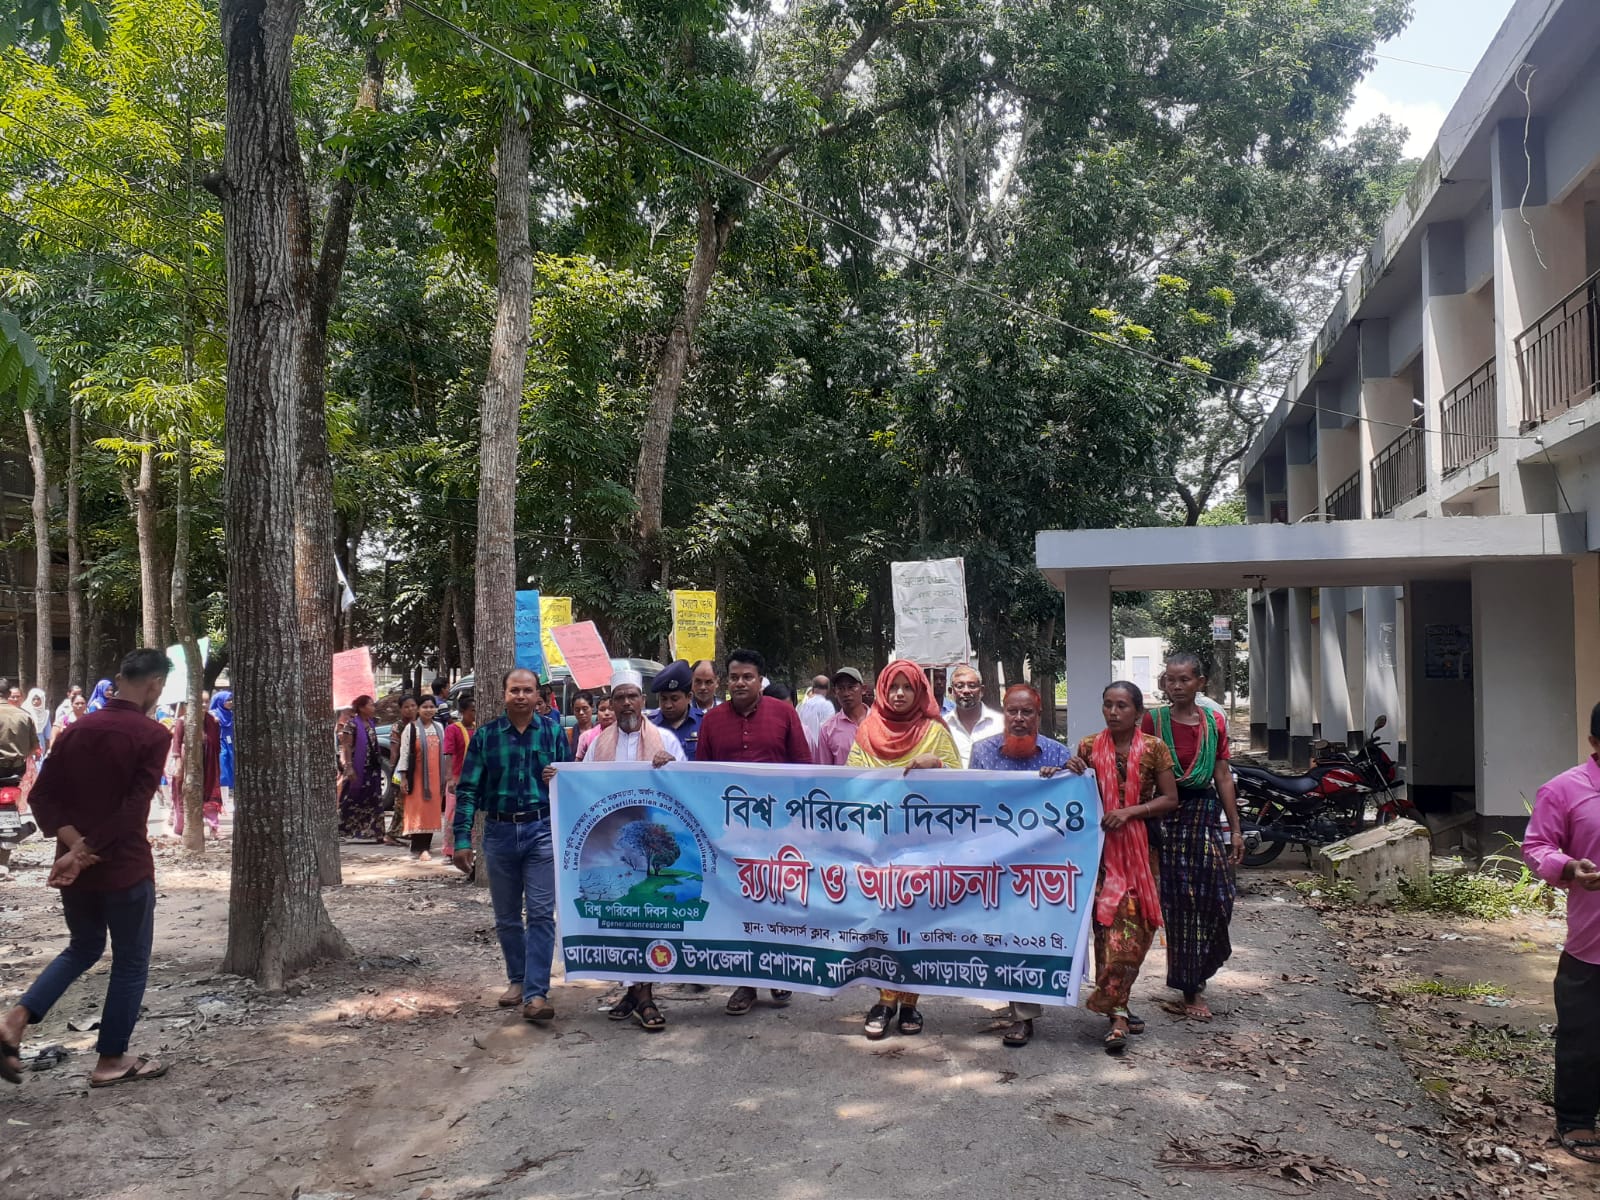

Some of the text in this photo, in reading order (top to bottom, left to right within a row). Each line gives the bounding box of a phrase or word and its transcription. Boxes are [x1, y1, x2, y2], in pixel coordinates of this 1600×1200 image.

[602, 798, 657, 814] Desertification
[659, 801, 673, 812] and
[722, 785, 1085, 836] বিশ্ব পরিবেশ দিবস-২০২৪
[820, 864, 847, 903] ও
[855, 860, 1006, 910] আলোচনা
[1009, 860, 1083, 912] সভা
[584, 901, 700, 919] বিশ্ব পরিবেশ দিবস ২০২৪
[601, 919, 681, 930] #generationrestoration
[767, 922, 807, 937] অফিসার্স
[961, 933, 978, 944] ০৫
[1012, 935, 1046, 948] ২০২৪
[681, 941, 753, 973] উপজেলা
[912, 957, 990, 988] খাগড়াছড়ি
[994, 959, 1046, 989] পার্বত্য
